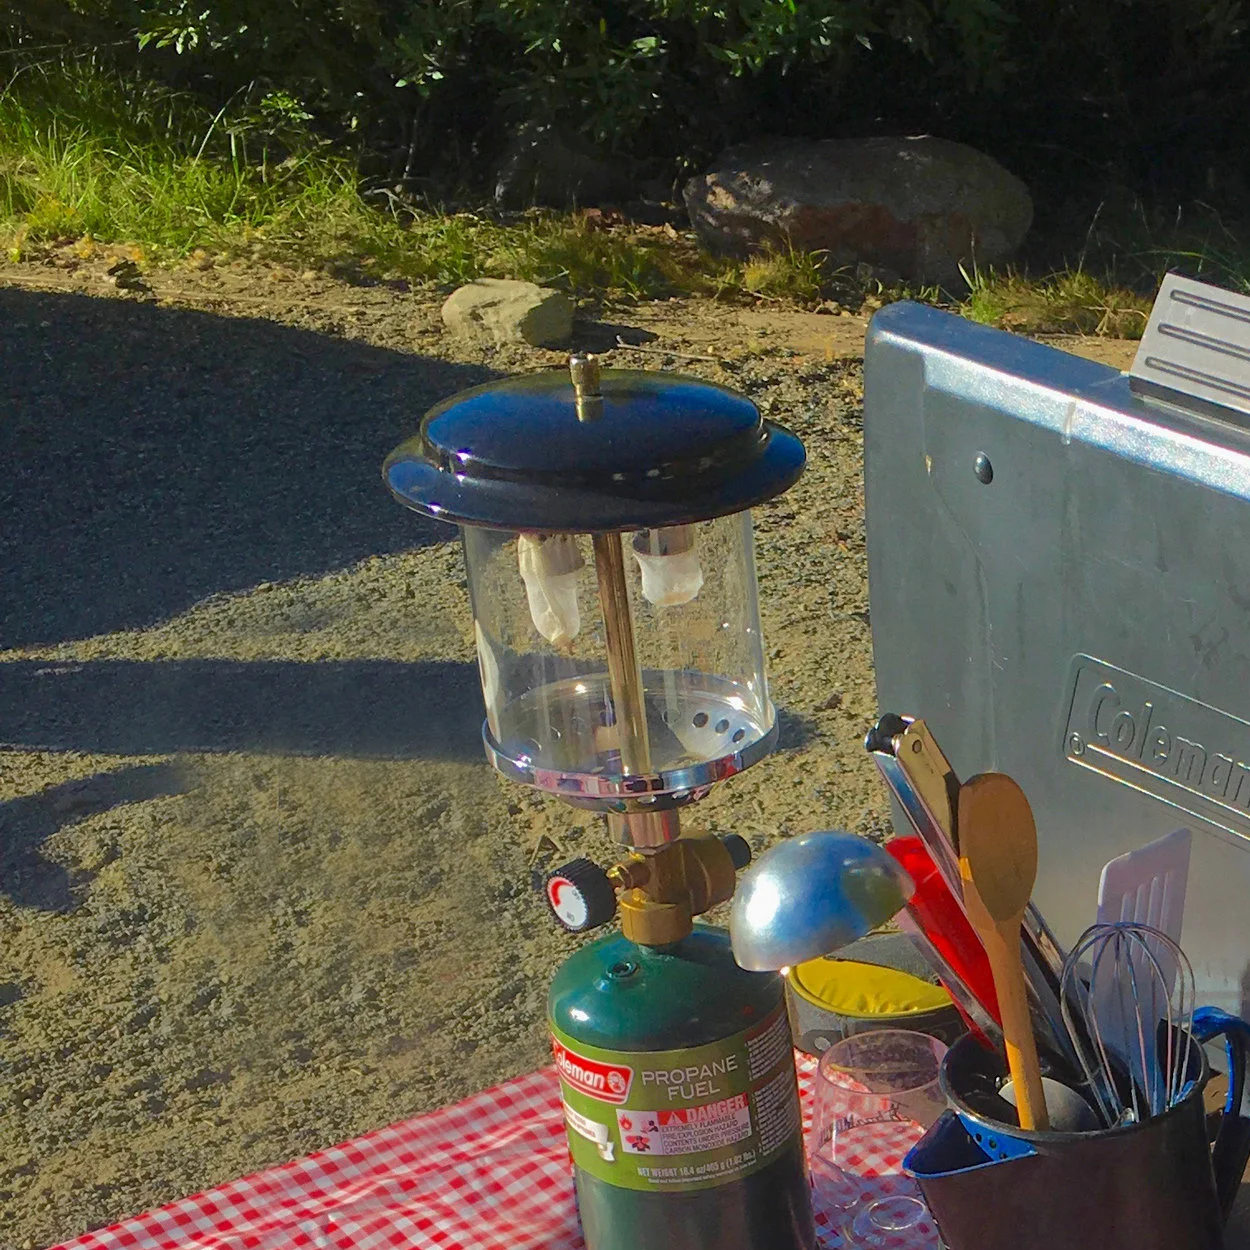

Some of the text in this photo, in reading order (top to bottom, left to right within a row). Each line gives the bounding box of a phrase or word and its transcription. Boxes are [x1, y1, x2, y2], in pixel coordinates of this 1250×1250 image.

[552, 1041, 605, 1090] oleman
[641, 1054, 738, 1086] PROPANE
[668, 1080, 721, 1101] FUEL
